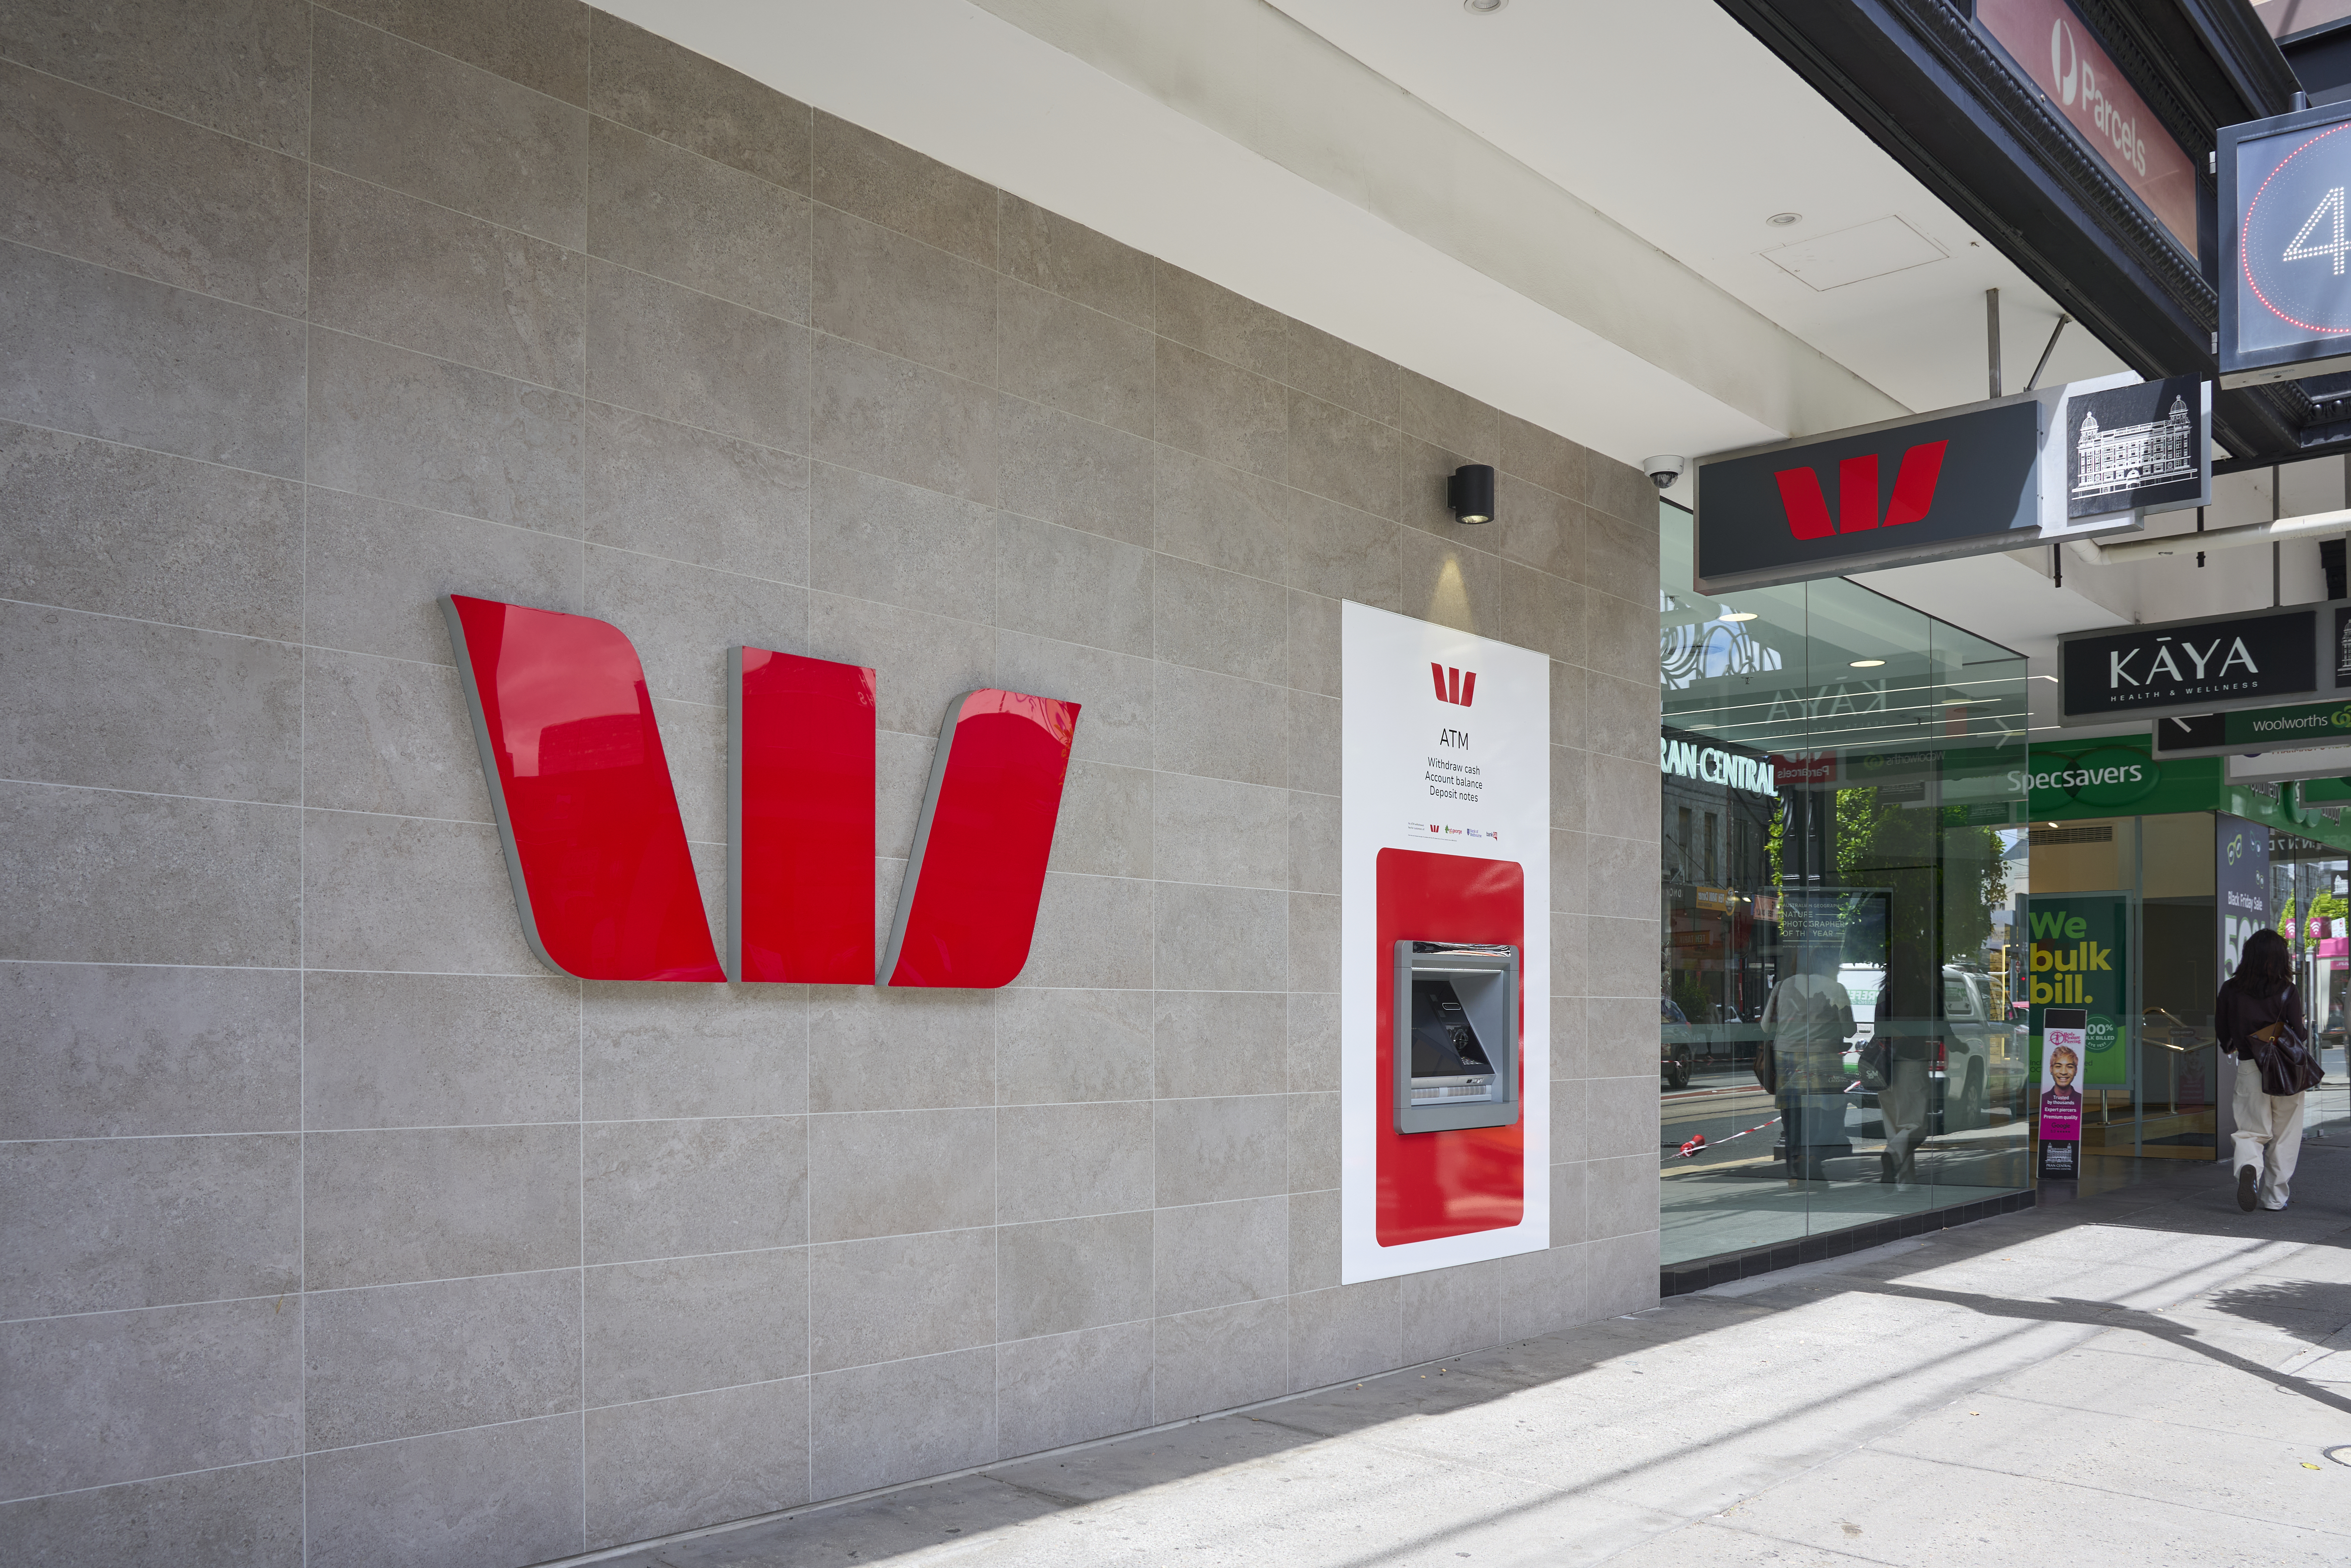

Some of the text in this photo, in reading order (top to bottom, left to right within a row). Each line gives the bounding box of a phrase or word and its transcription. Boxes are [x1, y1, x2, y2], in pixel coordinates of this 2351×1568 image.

[2082, 59, 2145, 177] Parcels
[2110, 636, 2258, 688] KĀYA
[2111, 692, 2159, 702] HEALTH
[2186, 681, 2257, 694] WELLNESS
[1440, 728, 1468, 750] ATM
[1428, 756, 1480, 775] Withdraw cash
[1700, 747, 1778, 797] CENTRAL
[1425, 771, 1483, 789] Account balance
[2007, 765, 2142, 795] Specsavers
[1430, 785, 1478, 802] Deposit notes
[2228, 891, 2263, 912] Black Friday Sale
[2029, 911, 2087, 940] We
[2030, 941, 2113, 972] bulk
[2030, 972, 2093, 1004] bill.
[2085, 1024, 2114, 1035] 00%
